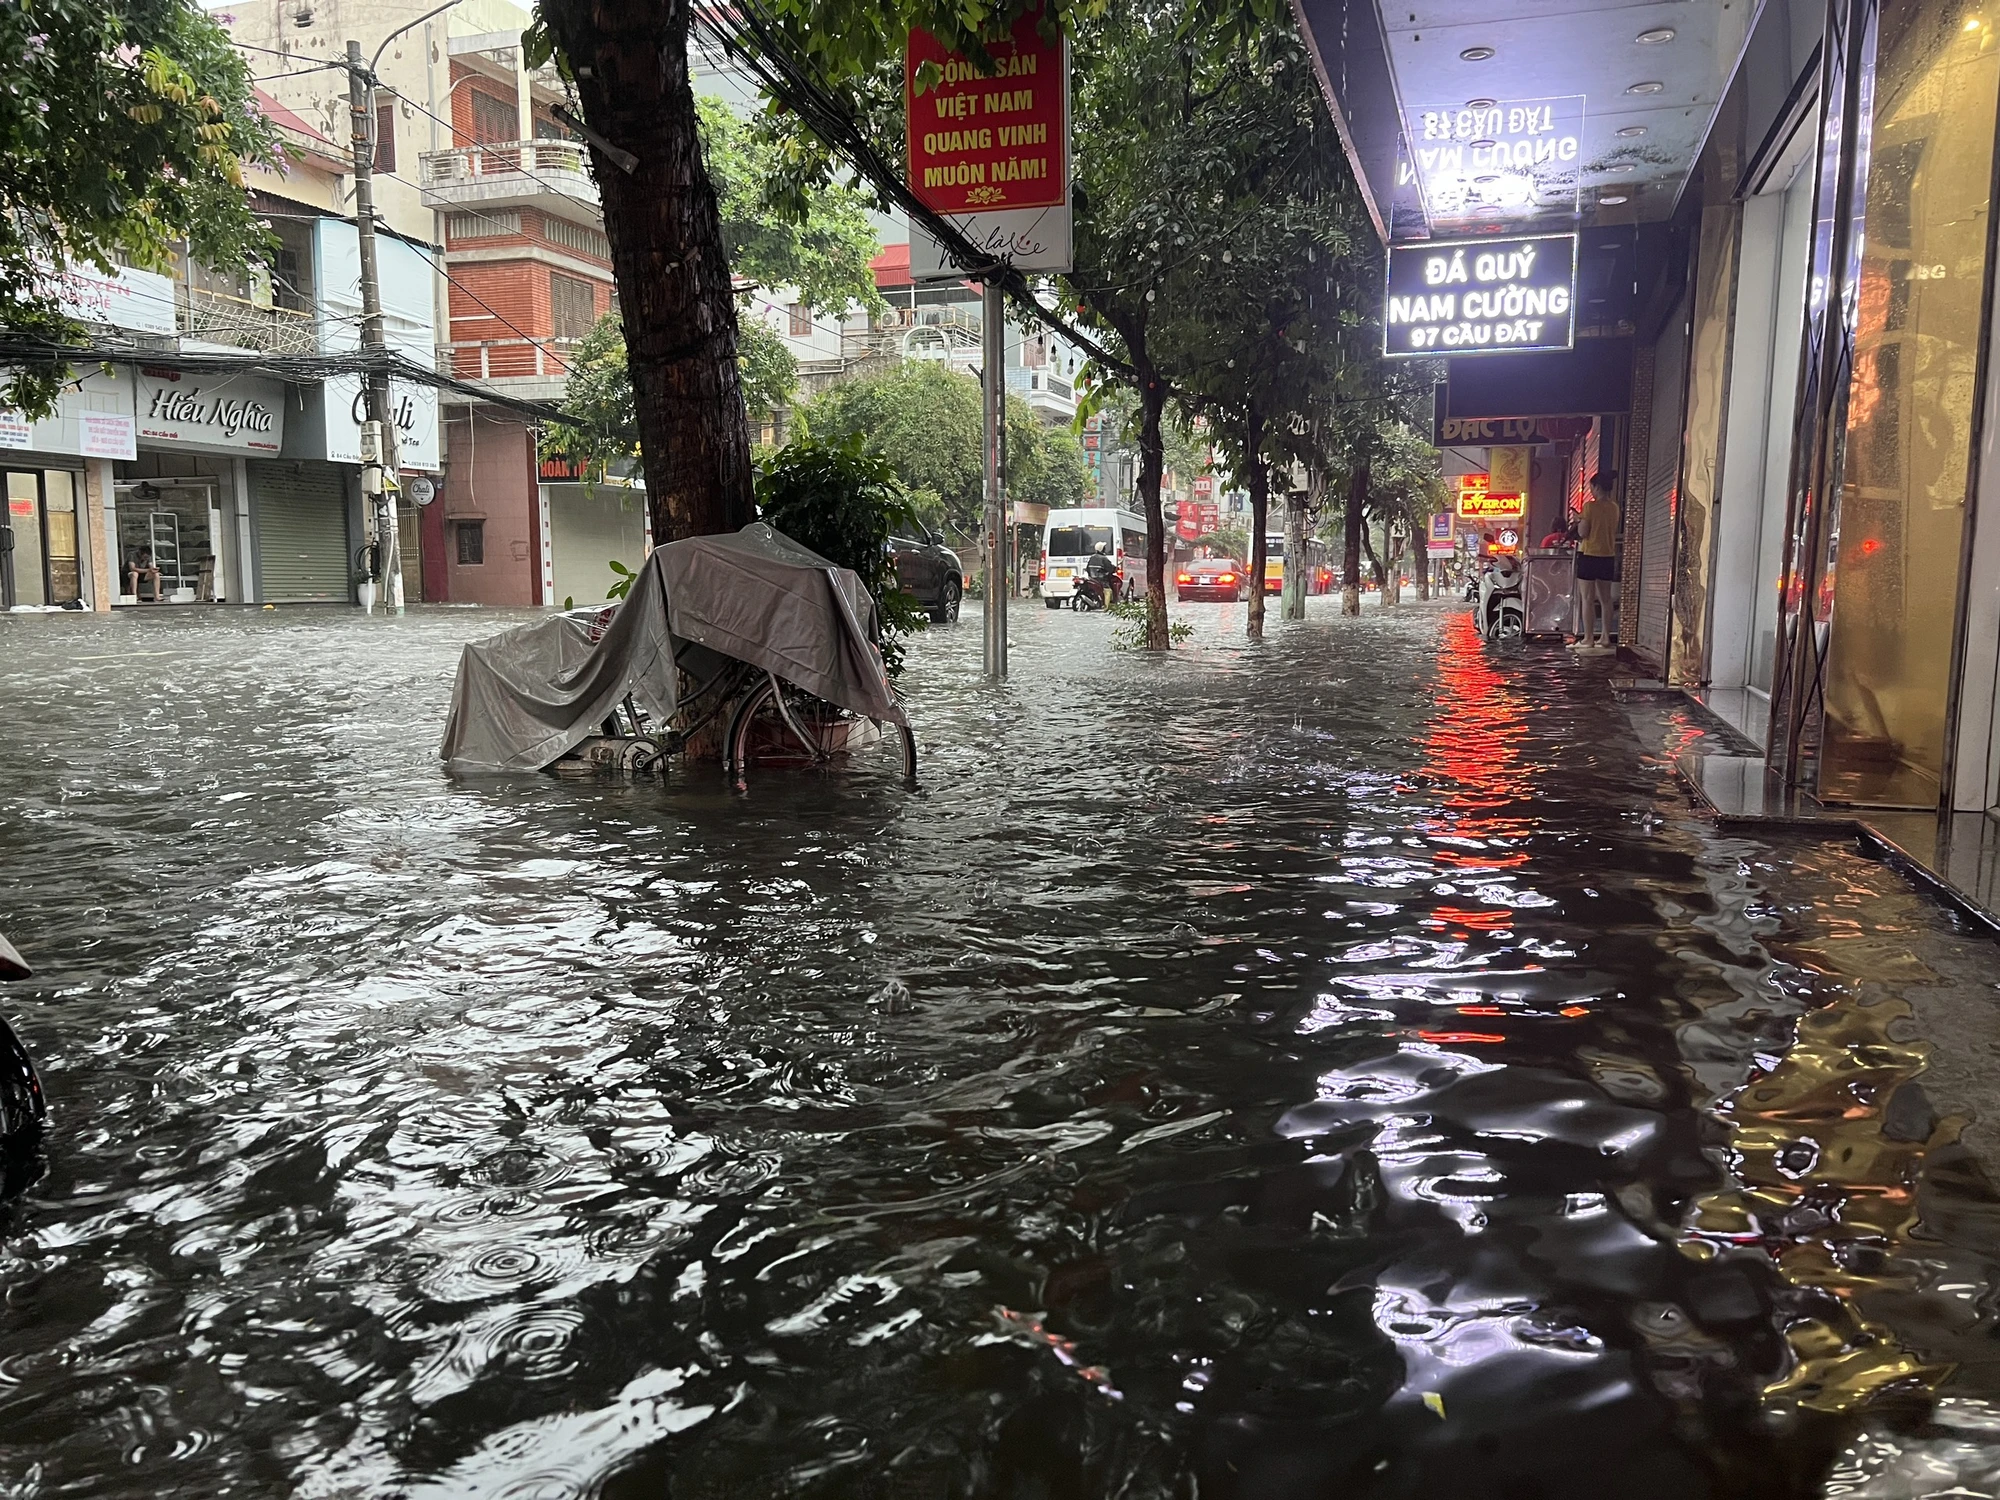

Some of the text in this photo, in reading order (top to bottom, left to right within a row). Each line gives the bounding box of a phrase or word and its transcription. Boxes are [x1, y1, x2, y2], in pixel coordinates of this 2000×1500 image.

[995, 50, 1037, 77] SẢN
[935, 89, 1033, 121] VIỆT NAM
[923, 123, 1047, 156] QUANG VINH
[924, 156, 1047, 188] MUÔN NĂM!
[1425, 244, 1536, 285] ĐÁ QUÝ
[1389, 283, 1569, 324] NAM CƯỜNG
[1411, 319, 1543, 348] 97 CẦU ĐẤT
[149, 387, 274, 438] Hiếu Nghĩa
[540, 457, 570, 477] HOÀN
[1201, 523, 1216, 533] 62
